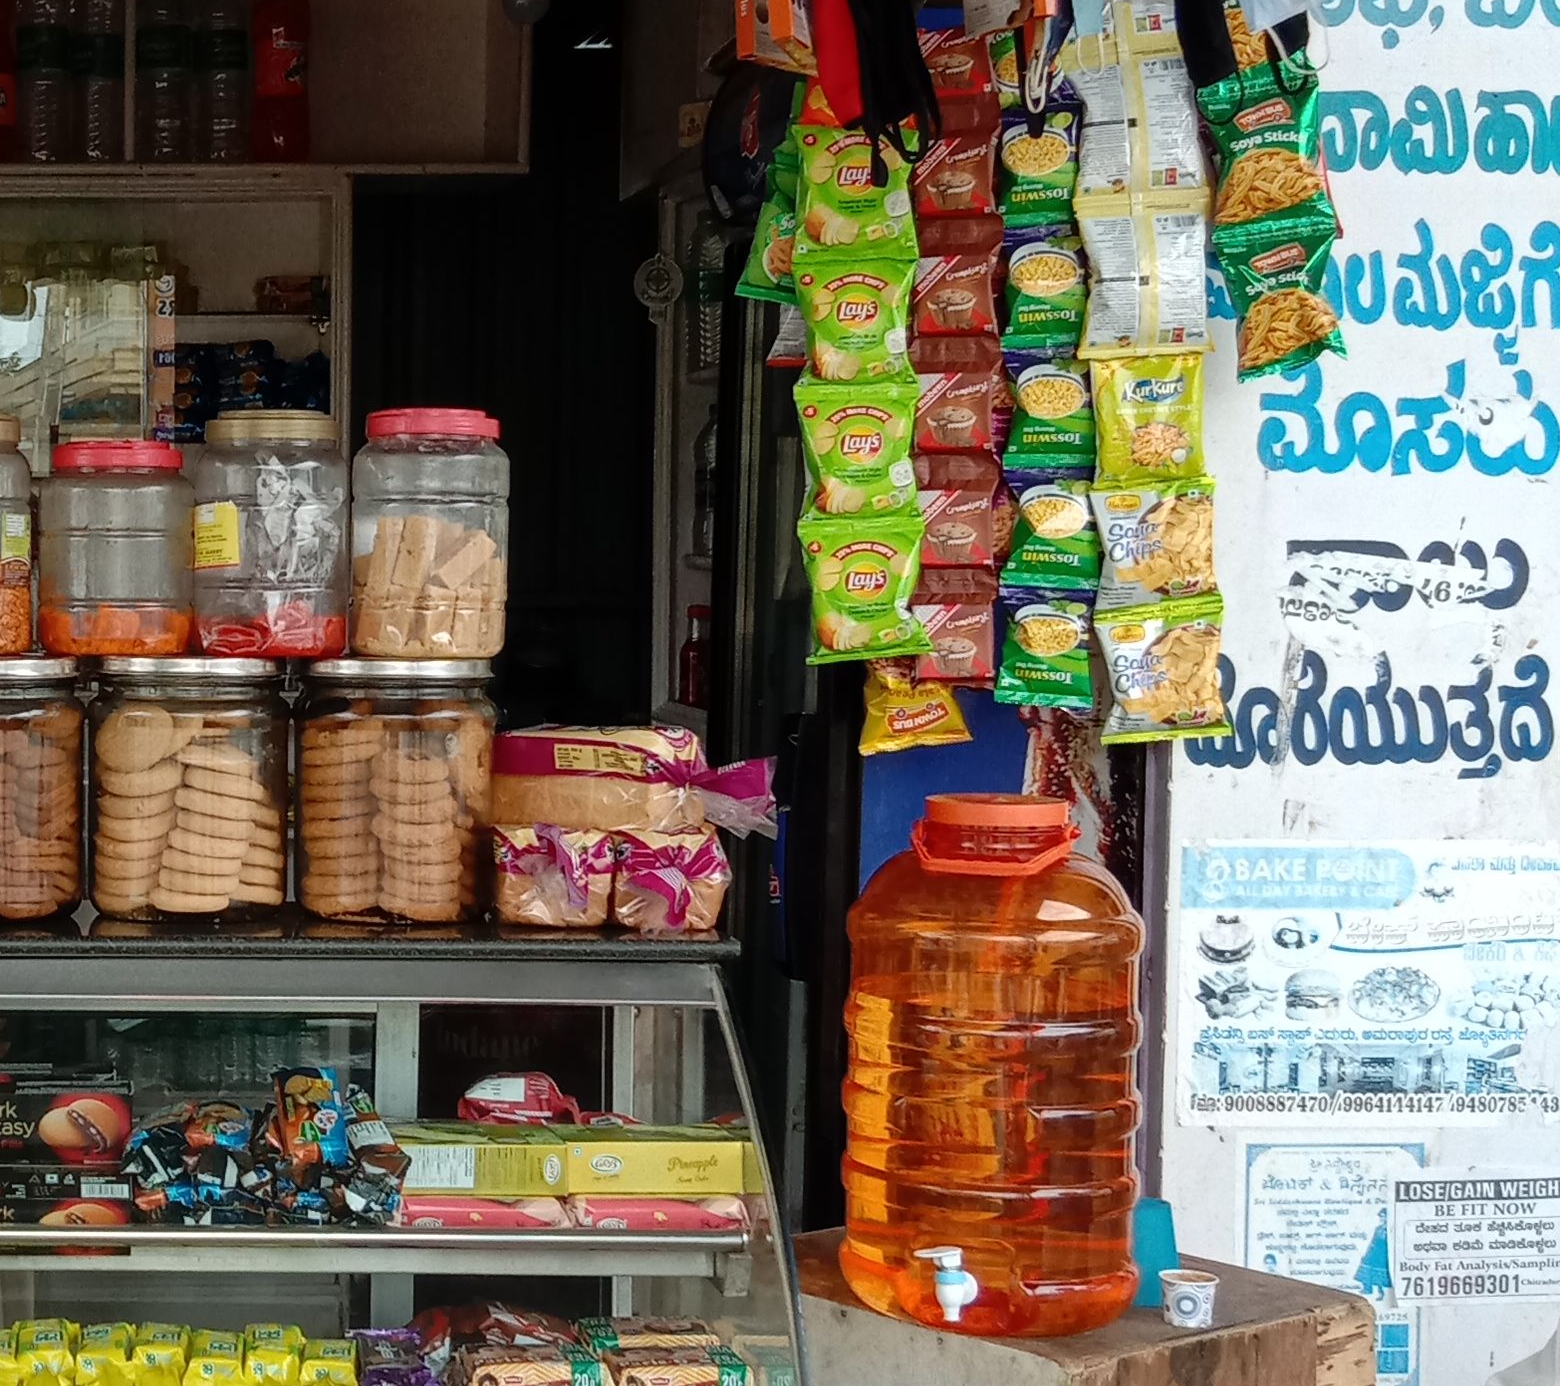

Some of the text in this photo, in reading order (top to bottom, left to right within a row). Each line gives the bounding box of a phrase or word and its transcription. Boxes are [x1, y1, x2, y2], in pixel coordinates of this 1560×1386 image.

[1229, 132, 1263, 154] Soya
[1010, 186, 1072, 203] Tosswin
[838, 300, 877, 323] Lay's
[1018, 308, 1079, 324] Tosswin
[841, 430, 881, 456] Lay's
[1021, 431, 1083, 445] Tosswin
[1107, 522, 1162, 545] Soya
[1020, 550, 1081, 565] Tosswin
[1109, 540, 1164, 563] Chips
[846, 569, 887, 592] Lay's
[1113, 652, 1164, 676] Soya
[1014, 668, 1074, 685] Tosswin
[1114, 669, 1168, 695] Chips
[1235, 858, 1306, 882] BAKE
[1398, 1181, 1495, 1202] LOSE/GAIN
[1434, 1202, 1538, 1217] BE FIT NOW
[1399, 1261, 1431, 1273] Body
[1434, 1261, 1453, 1272] Fat
[1401, 1273, 1520, 1297] 7619669301
